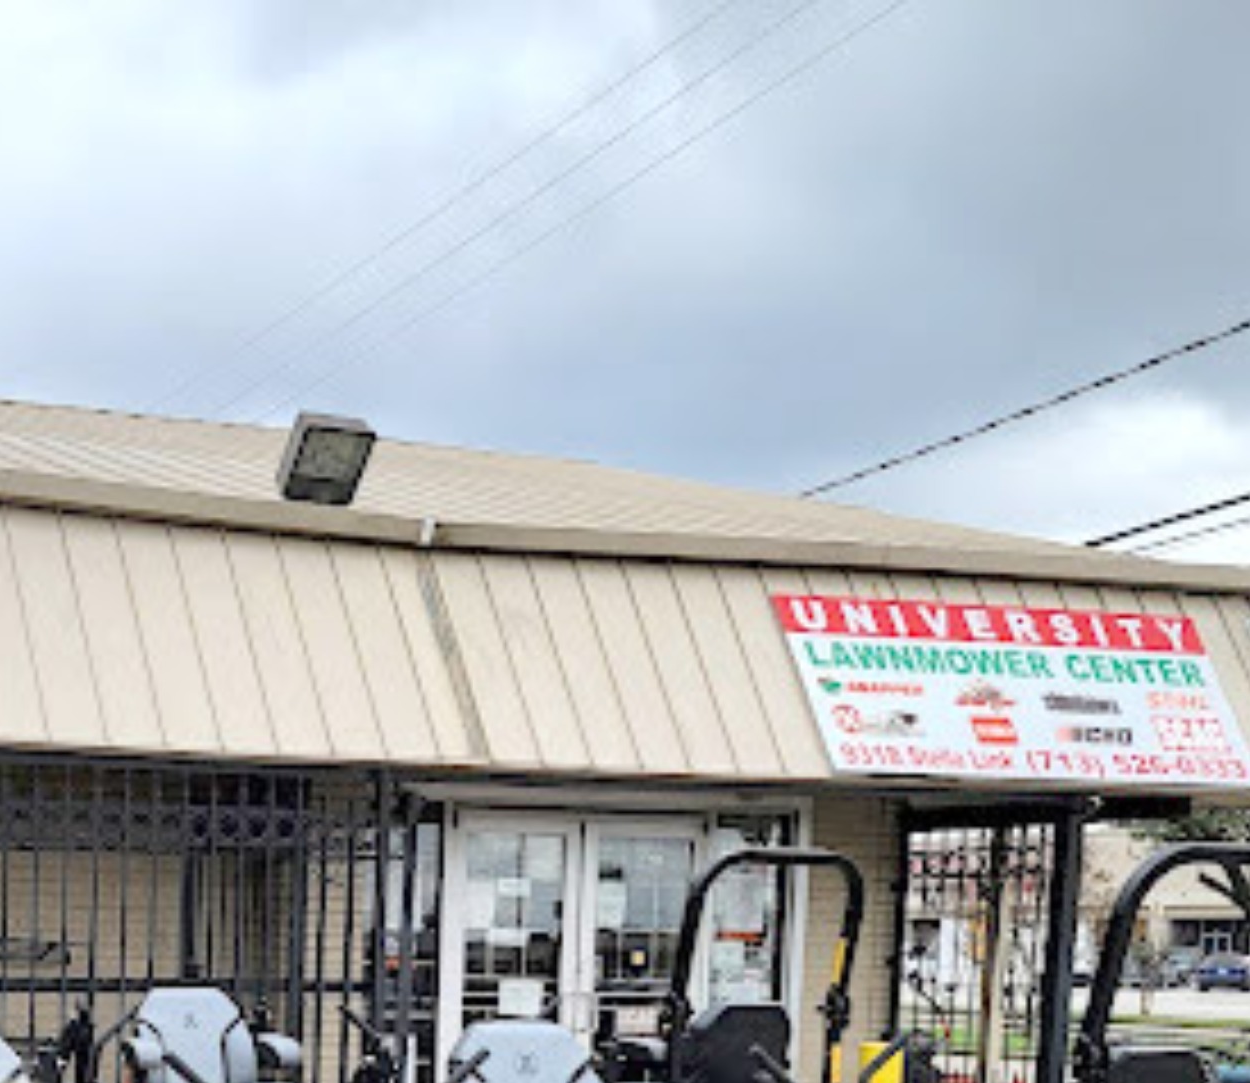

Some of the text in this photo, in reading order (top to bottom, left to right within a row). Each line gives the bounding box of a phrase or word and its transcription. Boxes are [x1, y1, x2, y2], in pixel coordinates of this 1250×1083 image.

[790, 599, 1184, 651] UNIVERSITY
[803, 640, 1205, 687] LAWNMOWER CENTER
